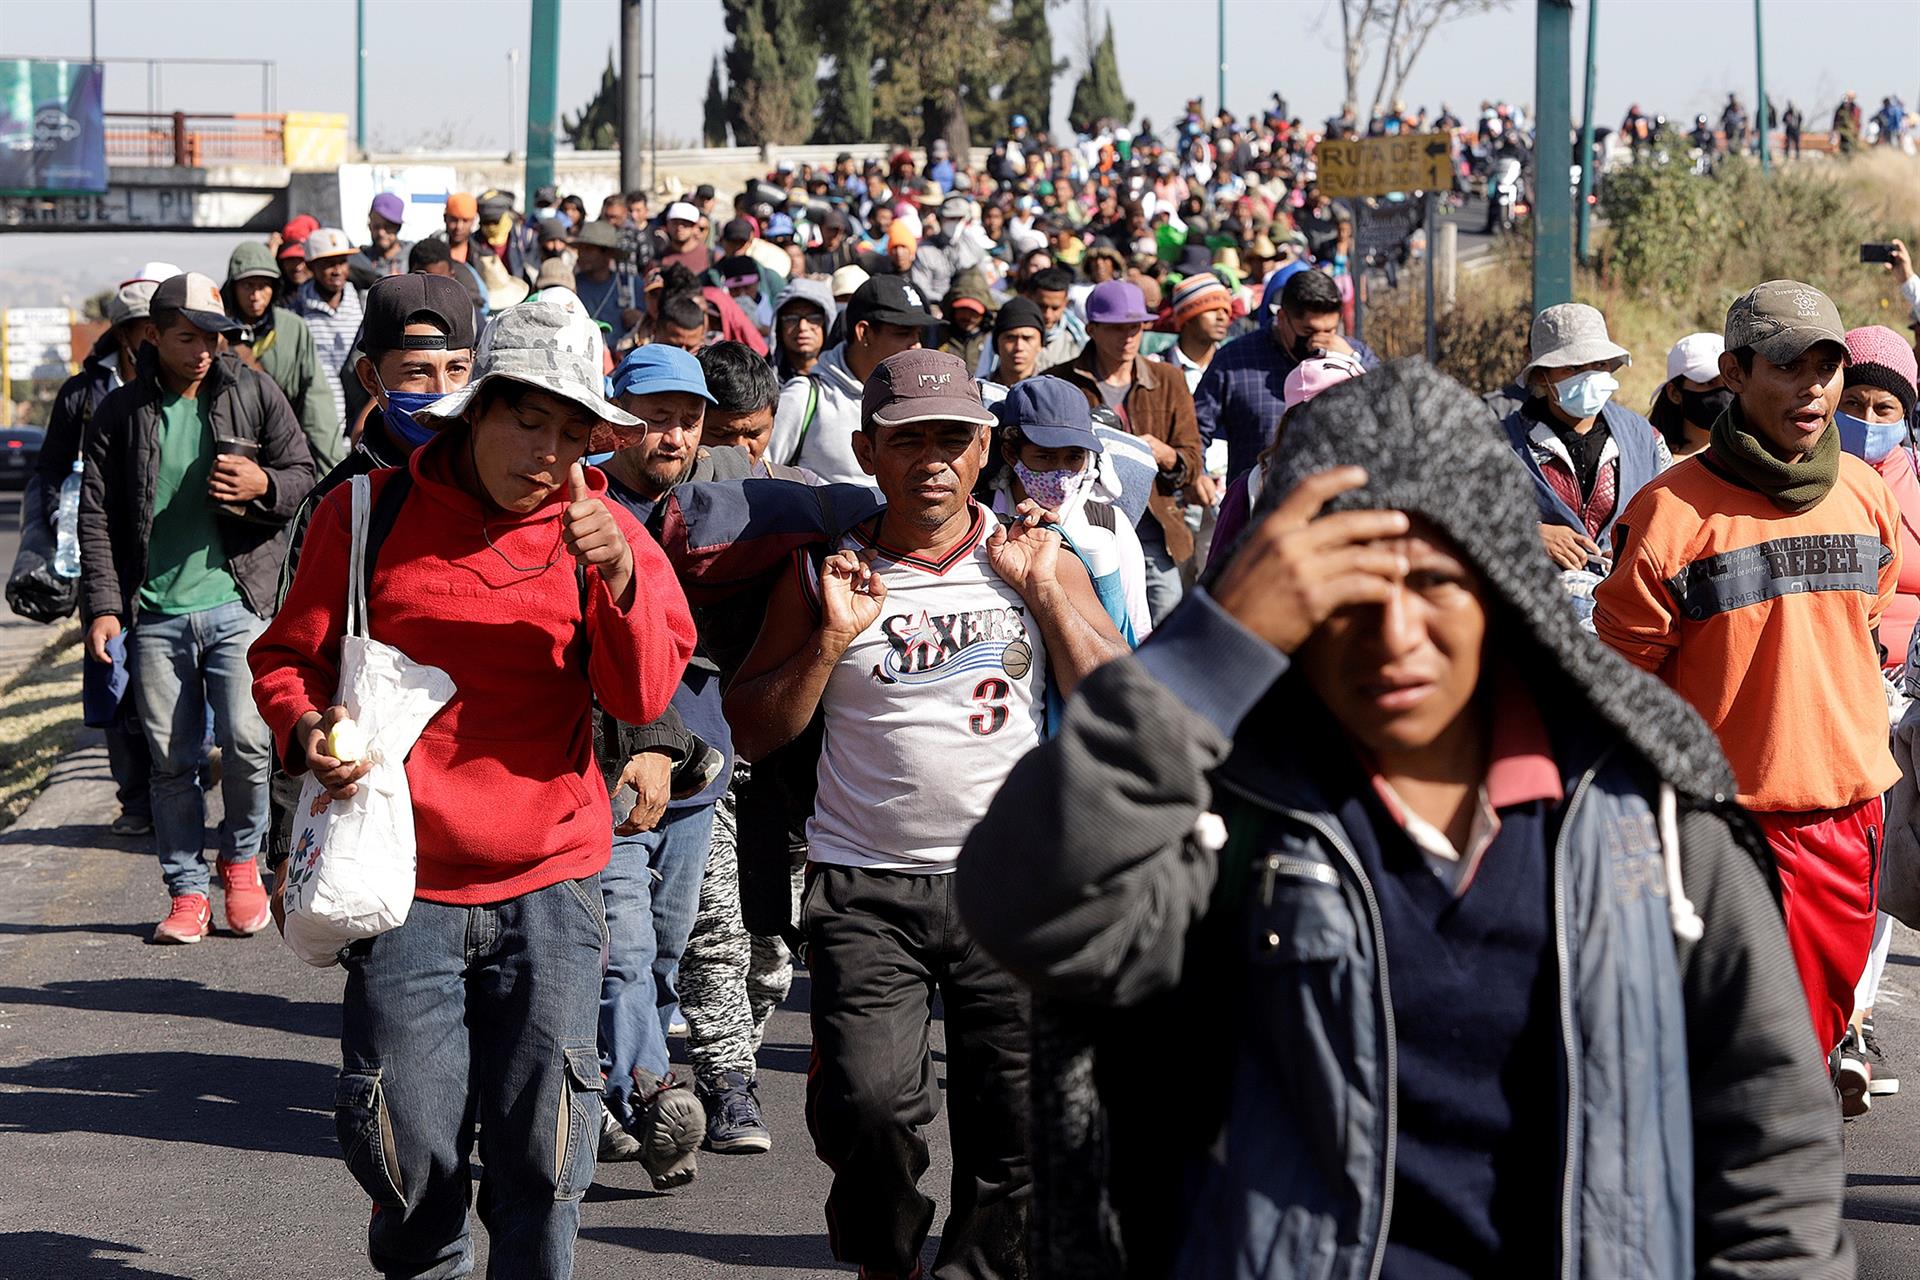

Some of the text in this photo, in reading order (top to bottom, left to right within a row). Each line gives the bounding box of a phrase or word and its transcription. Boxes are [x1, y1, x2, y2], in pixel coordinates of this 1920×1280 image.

[1322, 140, 1419, 167] RUTA DE
[1428, 165, 1438, 186] 1
[1759, 534, 1856, 557] AMERICAN
[1767, 548, 1863, 580] REBEL
[872, 606, 1026, 685] SIXERS
[969, 677, 1010, 737] 3
